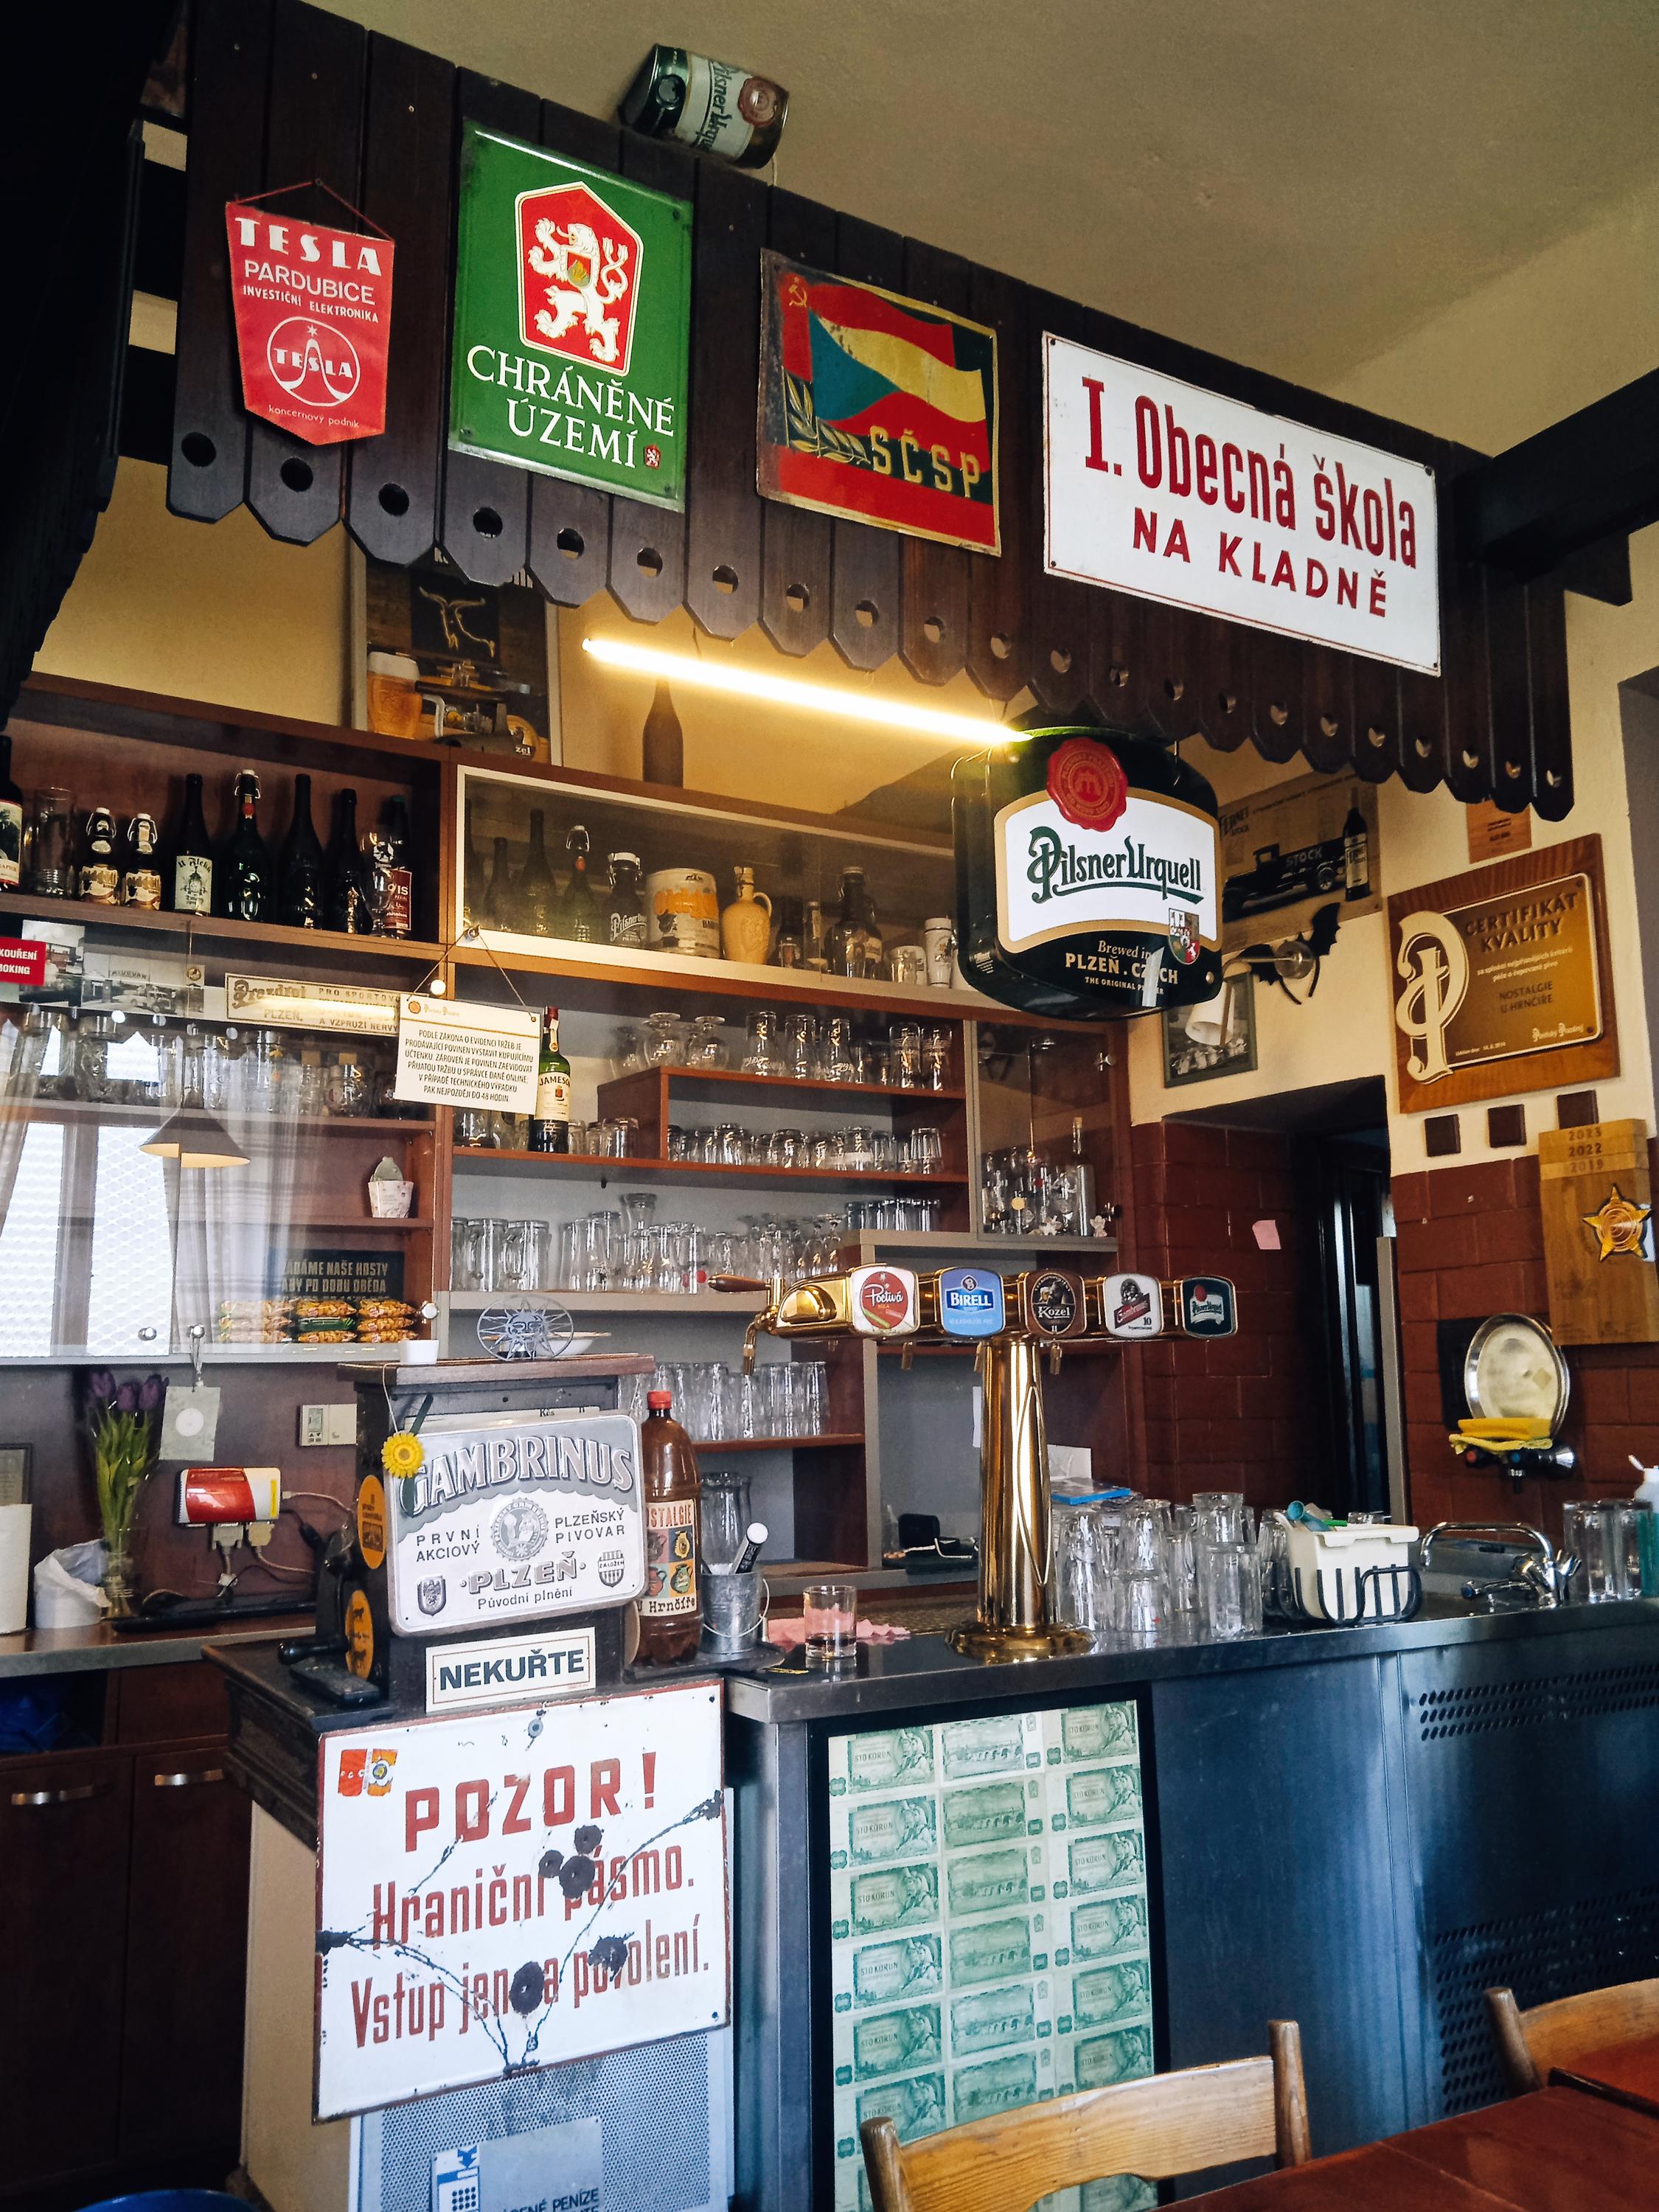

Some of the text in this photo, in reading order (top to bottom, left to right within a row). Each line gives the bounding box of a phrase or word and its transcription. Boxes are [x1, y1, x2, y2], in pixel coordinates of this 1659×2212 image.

[235, 218, 381, 276] TESLA
[245, 260, 375, 305] PARDUBICE
[243, 285, 378, 323] INVESTIČNÍ ELEKTRONIKA
[274, 348, 352, 378] TESLA
[467, 344, 675, 437] CHRÁNĚNÉ
[268, 405, 360, 428] koncernový podnik
[508, 398, 636, 469] ÚZEMÍ
[869, 425, 980, 498] SČSP
[1082, 377, 1416, 569] I. Obecná škola
[1133, 507, 1385, 617] NA KLADNĚ
[1026, 826, 1201, 904] Pilsner Urquell
[1286, 846, 1322, 867] STOCK
[1480, 918, 1563, 953] KVALITY
[1098, 940, 1138, 959] Brewed
[0, 963, 30, 975] OKING
[1065, 953, 1178, 984] PLZEŇ CZCH
[1085, 976, 1099, 985] THE
[1101, 978, 1135, 990] ORIGINAL
[1499, 981, 1553, 1001] NOSTALGIE
[370, 1023, 398, 1032] NERVY
[406, 1038, 534, 1062] PRODÁVAJÍCÍ POVINEN VYSTAVIT KUPUJÍCÍMU
[419, 1029, 437, 1039] PODLE
[439, 1032, 463, 1042] ZÁKONA
[470, 1037, 496, 1047] EVIDENCI
[498, 1040, 515, 1050] TRŽEB
[408, 1061, 436, 1071] PŘIJATOU
[437, 1065, 456, 1074] TRŽBU
[463, 1068, 487, 1078] SPRÁVCE
[490, 1071, 505, 1080] DANĚ
[436, 1053, 463, 1064] ZÁROVEŇ
[472, 1059, 497, 1068] POVINEN
[498, 1062, 532, 1073] ZAEVIDOVAT
[424, 1074, 449, 1085] PŘÍPADĚ
[451, 1077, 490, 1089] TECHNICKÉHO
[490, 1082, 518, 1093] VÝPADKU
[424, 1085, 435, 1093] PAK
[437, 1088, 470, 1098] NEJPOZDĚJI
[472, 1091, 480, 1099] DO
[481, 1092, 489, 1100] 48
[539, 1076, 571, 1088] JAMESO
[1569, 1143, 1601, 1157] 2022
[327, 1260, 353, 1276] NAŠE
[356, 1262, 388, 1276] HOSTY
[306, 1278, 319, 1292] PO
[322, 1278, 350, 1292] DOBU
[864, 1283, 992, 1307] Poctivá BIRELL
[1038, 1306, 1071, 1318] Kozel
[1143, 1316, 1152, 1326] 10
[399, 1435, 634, 1517] GAMBRINUS
[555, 1507, 625, 1528] PLZEŇSKÝ
[647, 1504, 692, 1528] STALGIE
[417, 1526, 480, 1546] PRVNÍ
[556, 1525, 625, 1543] PIVOVAR
[417, 1541, 480, 1562] AKCIOVÝ
[467, 1551, 577, 1594] PLZEŇ
[478, 1587, 573, 1610] Původní plnění
[649, 1597, 695, 1613] Hrnčíře
[440, 1648, 584, 1691] NEKUŘTE
[855, 1750, 891, 1763] STO KORUN
[406, 1752, 656, 1852] POZOR!
[857, 1822, 893, 1834] STO KORUN
[1086, 1854, 1106, 1864] KORUN
[872, 1891, 895, 1902] KORUN
[860, 1962, 898, 1976] STO KORUN
[351, 1972, 445, 2048] Vstup
[459, 1963, 509, 2035] jen
[553, 2188, 599, 2211] PENÍZE
